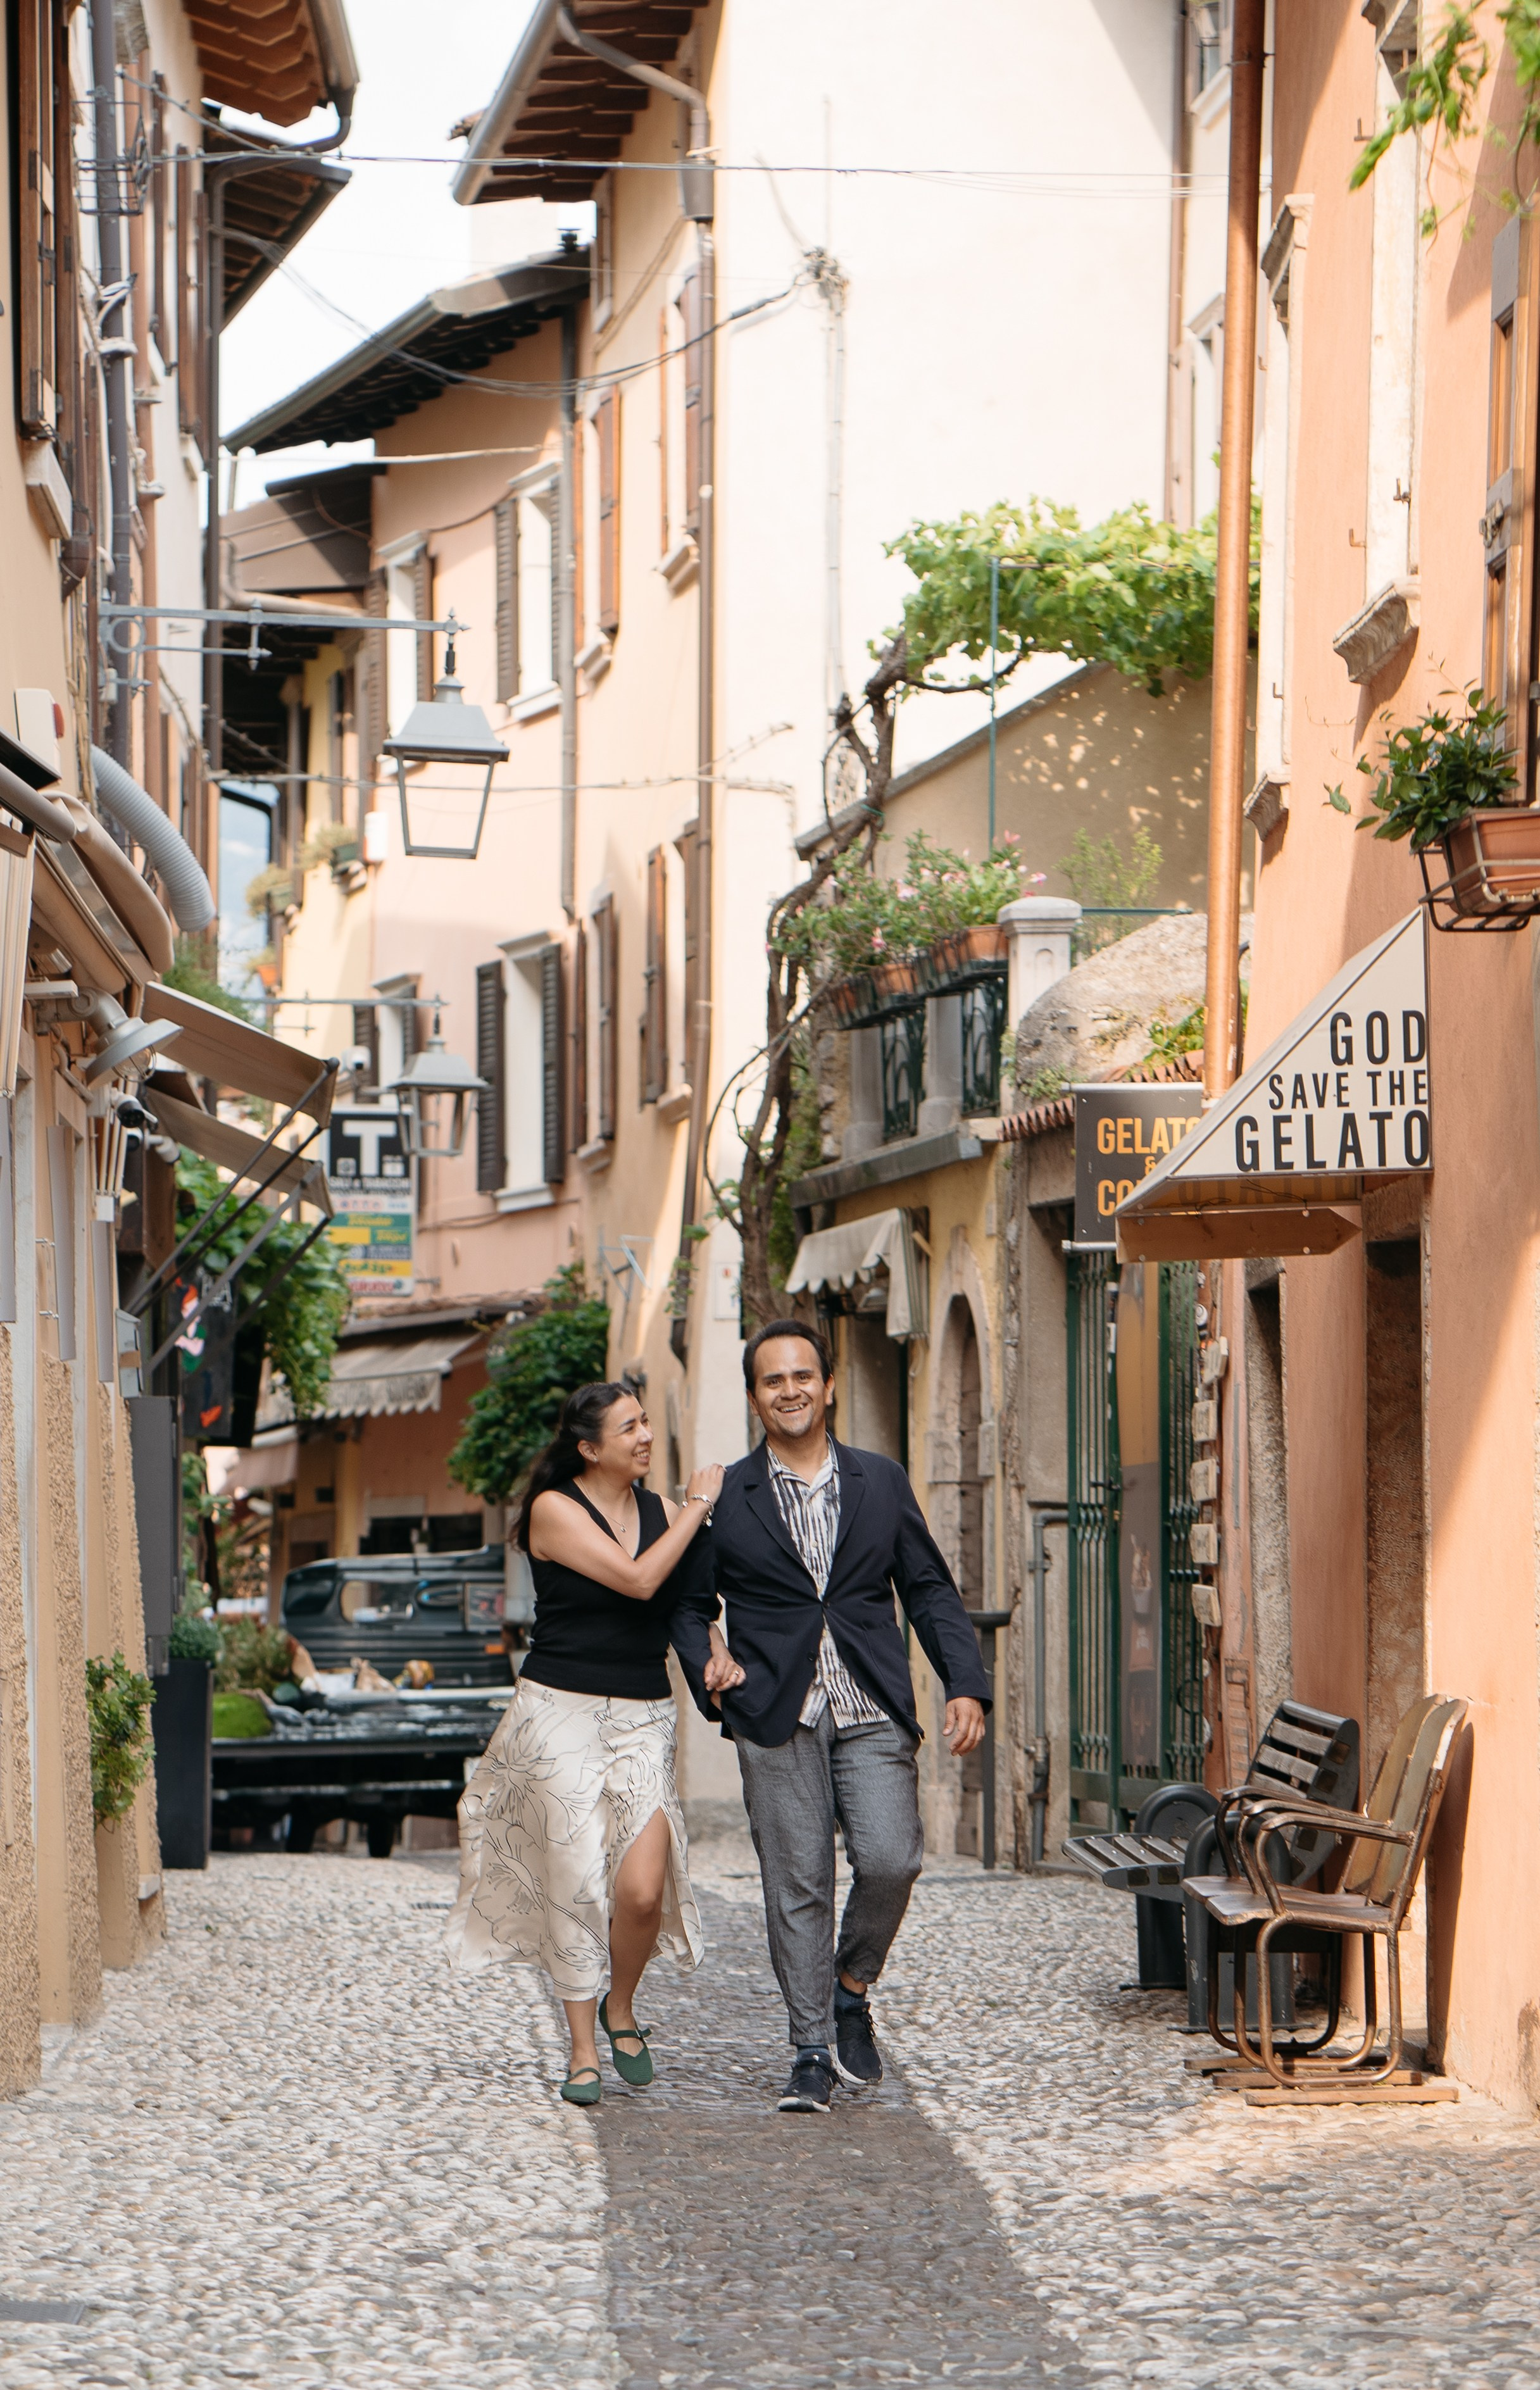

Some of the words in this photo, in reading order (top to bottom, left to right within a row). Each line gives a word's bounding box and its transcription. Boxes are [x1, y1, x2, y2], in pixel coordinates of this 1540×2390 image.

[1330, 1010, 1425, 1066] GOD
[1269, 1072, 1349, 1110] SAVE
[1366, 1069, 1428, 1106] THE
[342, 1120, 397, 1175] T
[1235, 1110, 1429, 1172] GELATO
